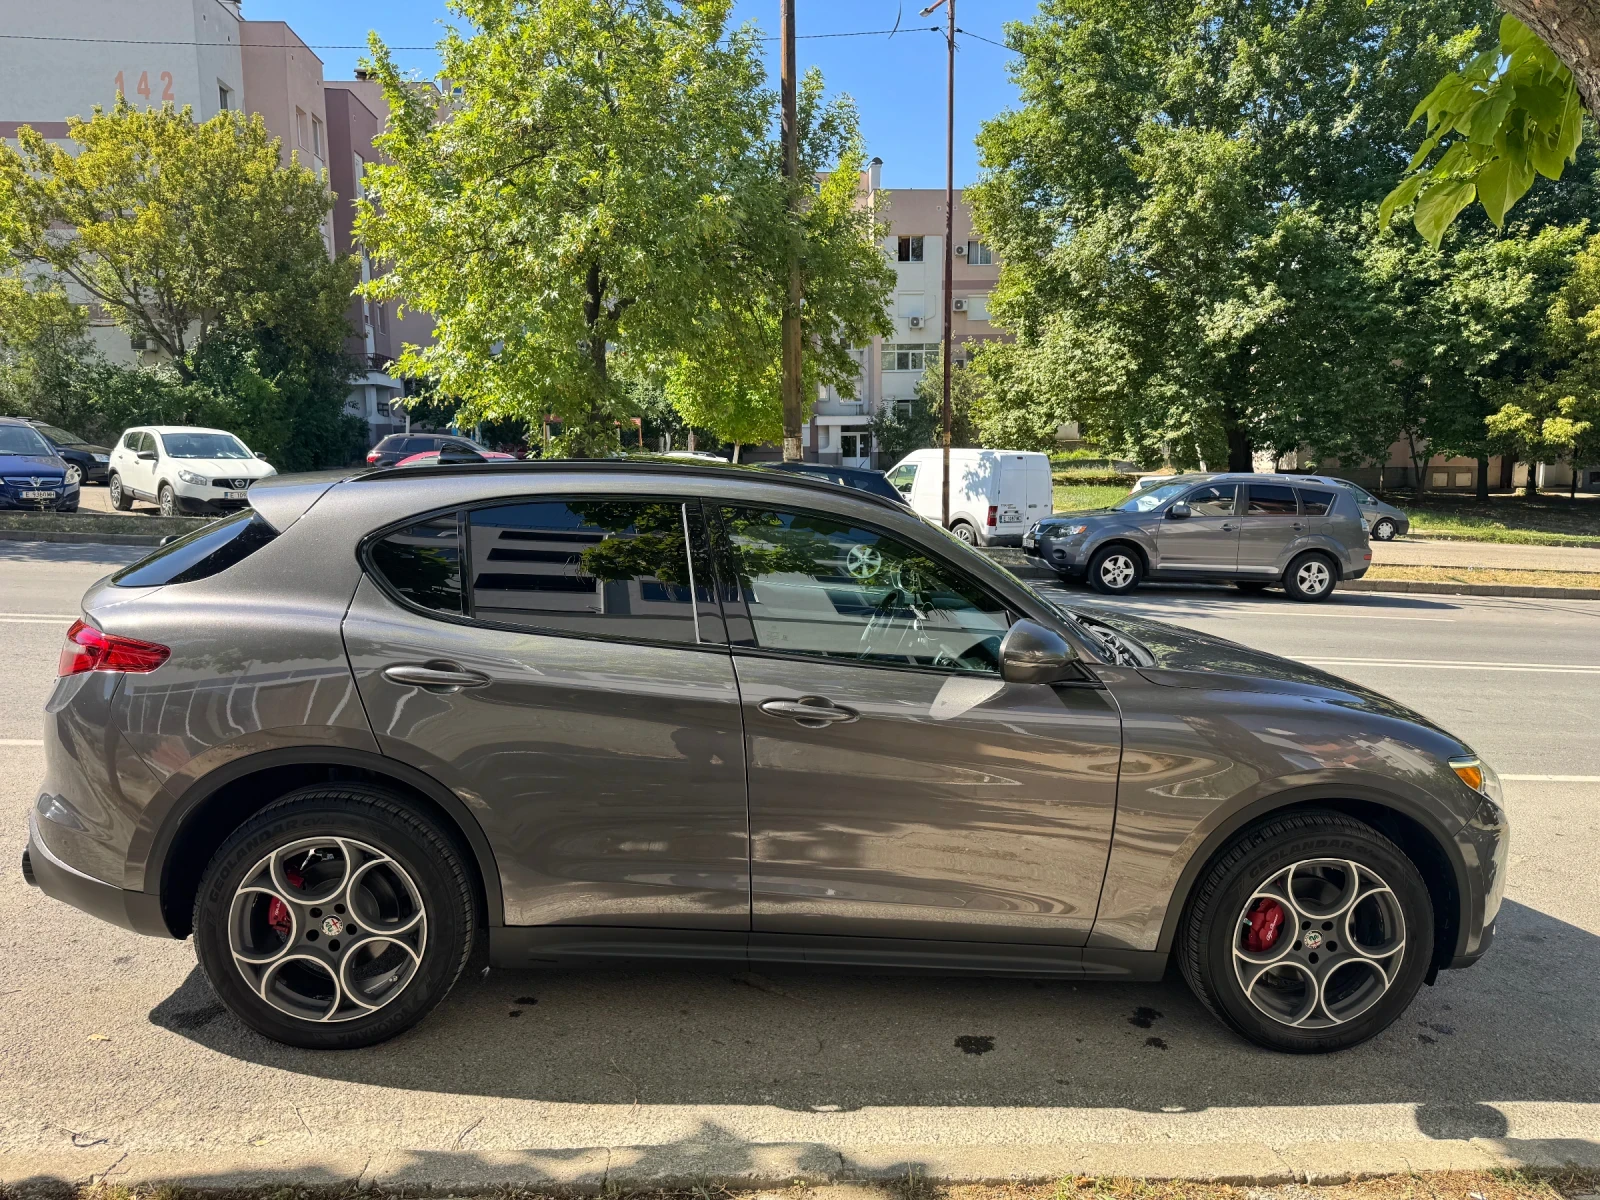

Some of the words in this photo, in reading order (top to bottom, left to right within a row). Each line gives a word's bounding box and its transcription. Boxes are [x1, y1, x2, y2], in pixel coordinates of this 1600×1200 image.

[114, 70, 175, 101] 142
[209, 819, 299, 903] GEOLANDAR
[1249, 839, 1354, 879] GEOLANDAR
